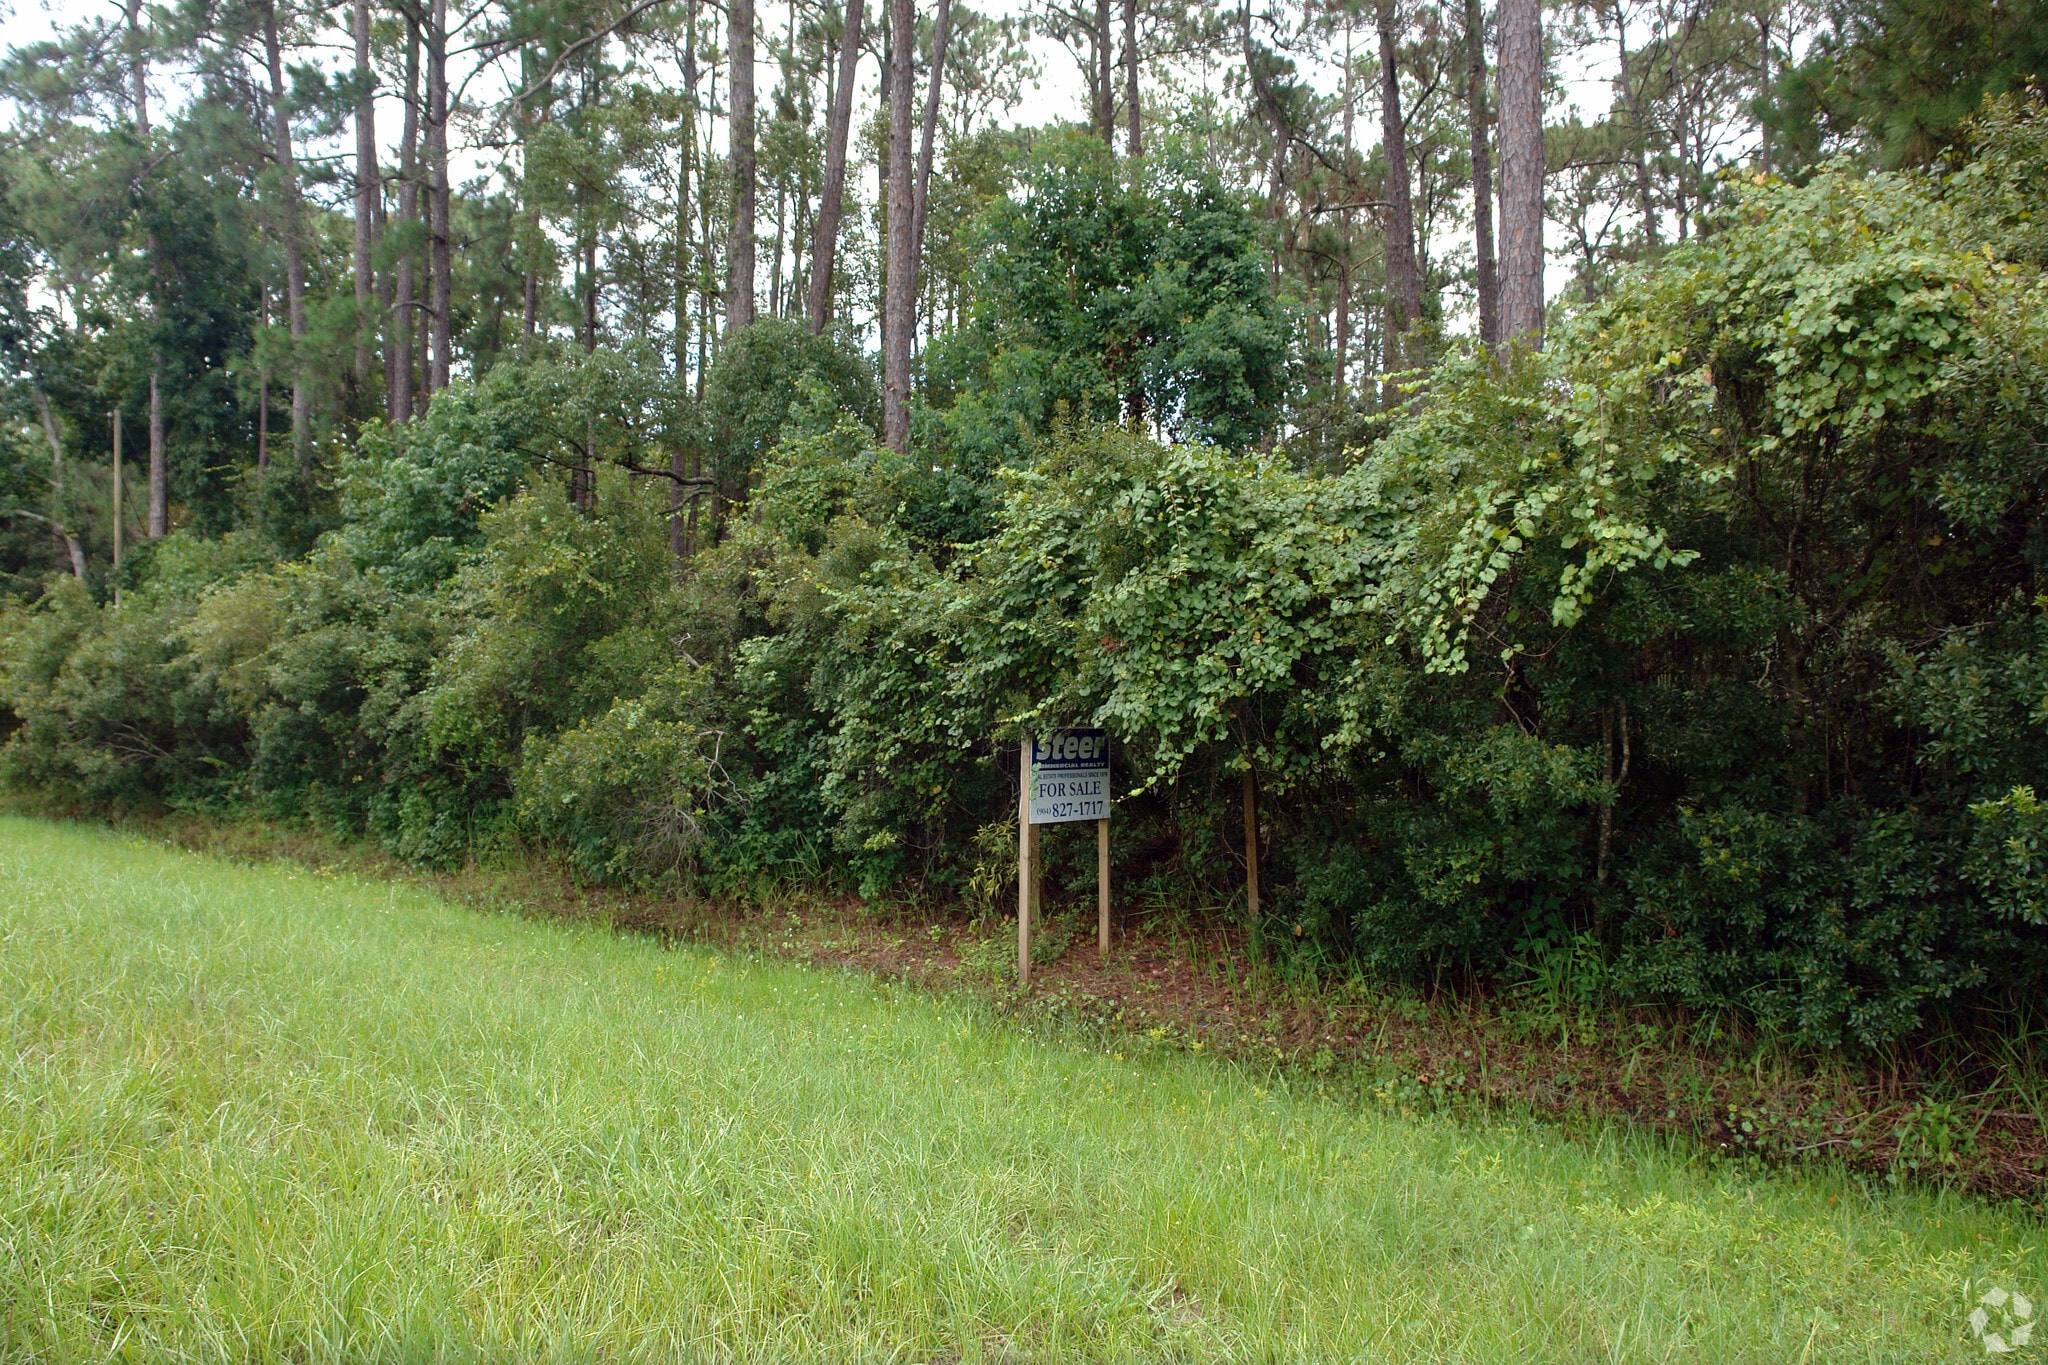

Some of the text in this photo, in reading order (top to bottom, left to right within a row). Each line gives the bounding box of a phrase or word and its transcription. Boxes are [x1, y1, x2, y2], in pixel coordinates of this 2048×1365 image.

[1036, 732, 1105, 760] Steer
[1039, 781, 1101, 798] FOR SALE
[1053, 801, 1103, 817] 827-1717
